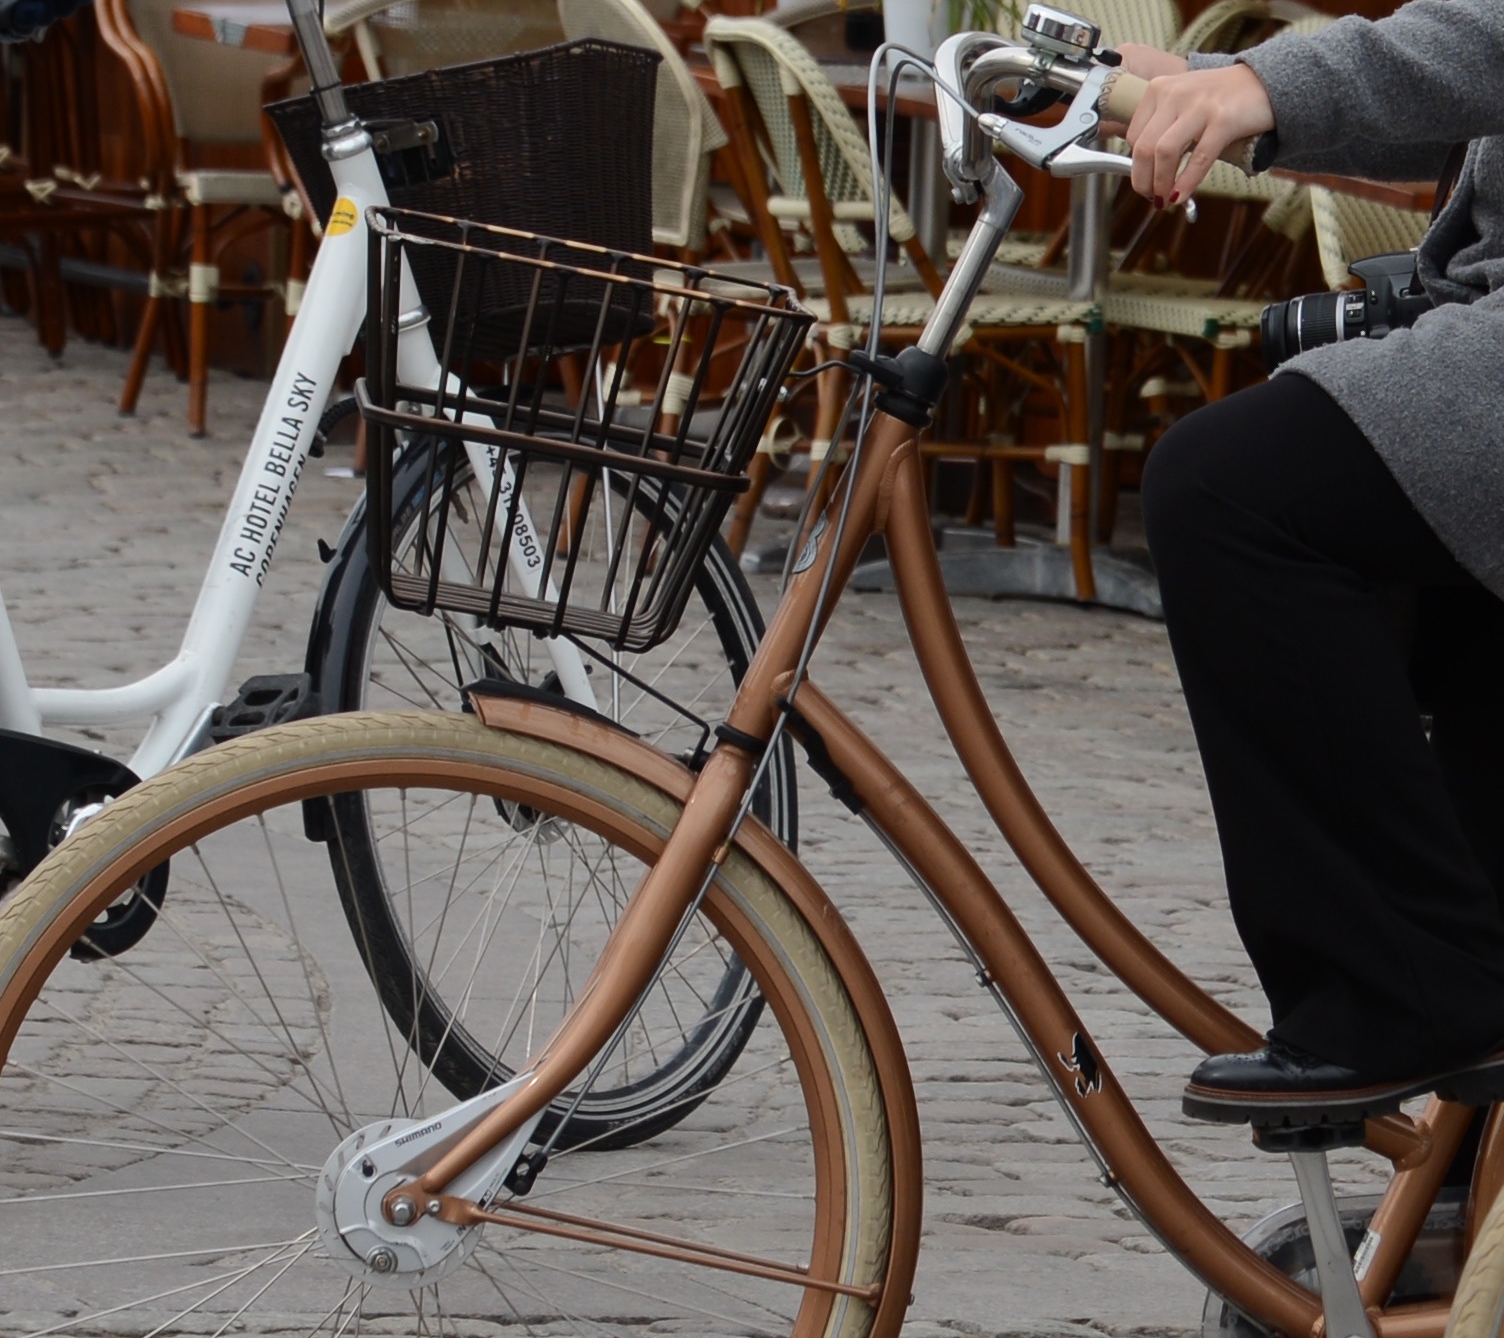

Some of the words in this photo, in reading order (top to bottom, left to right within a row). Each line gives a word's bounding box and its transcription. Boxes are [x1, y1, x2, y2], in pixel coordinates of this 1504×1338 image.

[286, 371, 317, 413] SKY
[264, 416, 304, 477] BELLA
[240, 483, 281, 544] HOTEL
[230, 547, 256, 577] AC
[395, 1121, 443, 1148] SHIMANO
